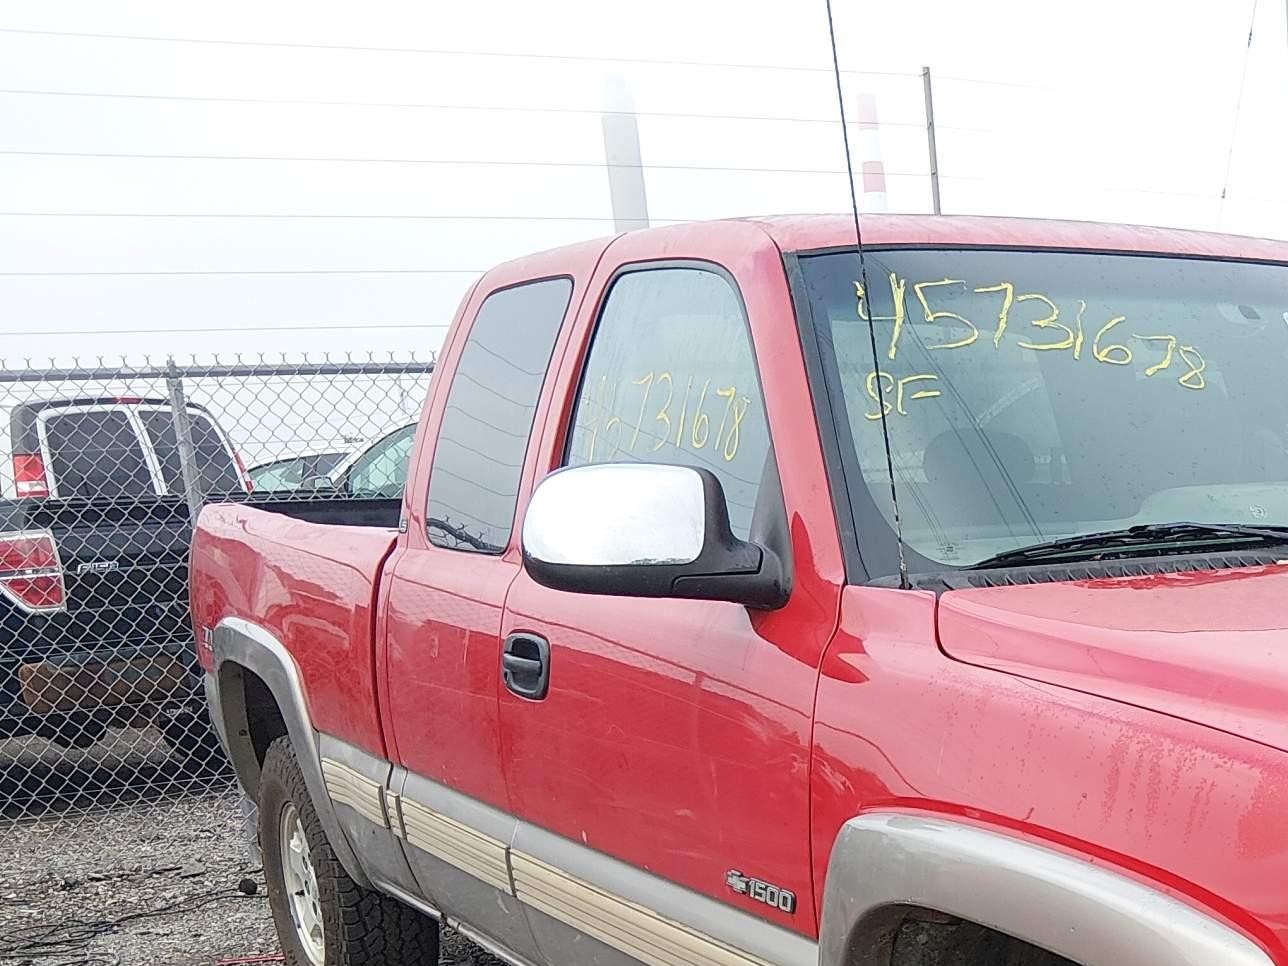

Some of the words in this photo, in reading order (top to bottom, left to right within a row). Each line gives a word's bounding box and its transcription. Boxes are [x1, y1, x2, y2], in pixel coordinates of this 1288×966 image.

[852, 273, 1206, 389] 45731678
[864, 371, 942, 420] SF
[749, 877, 796, 913] 1500
